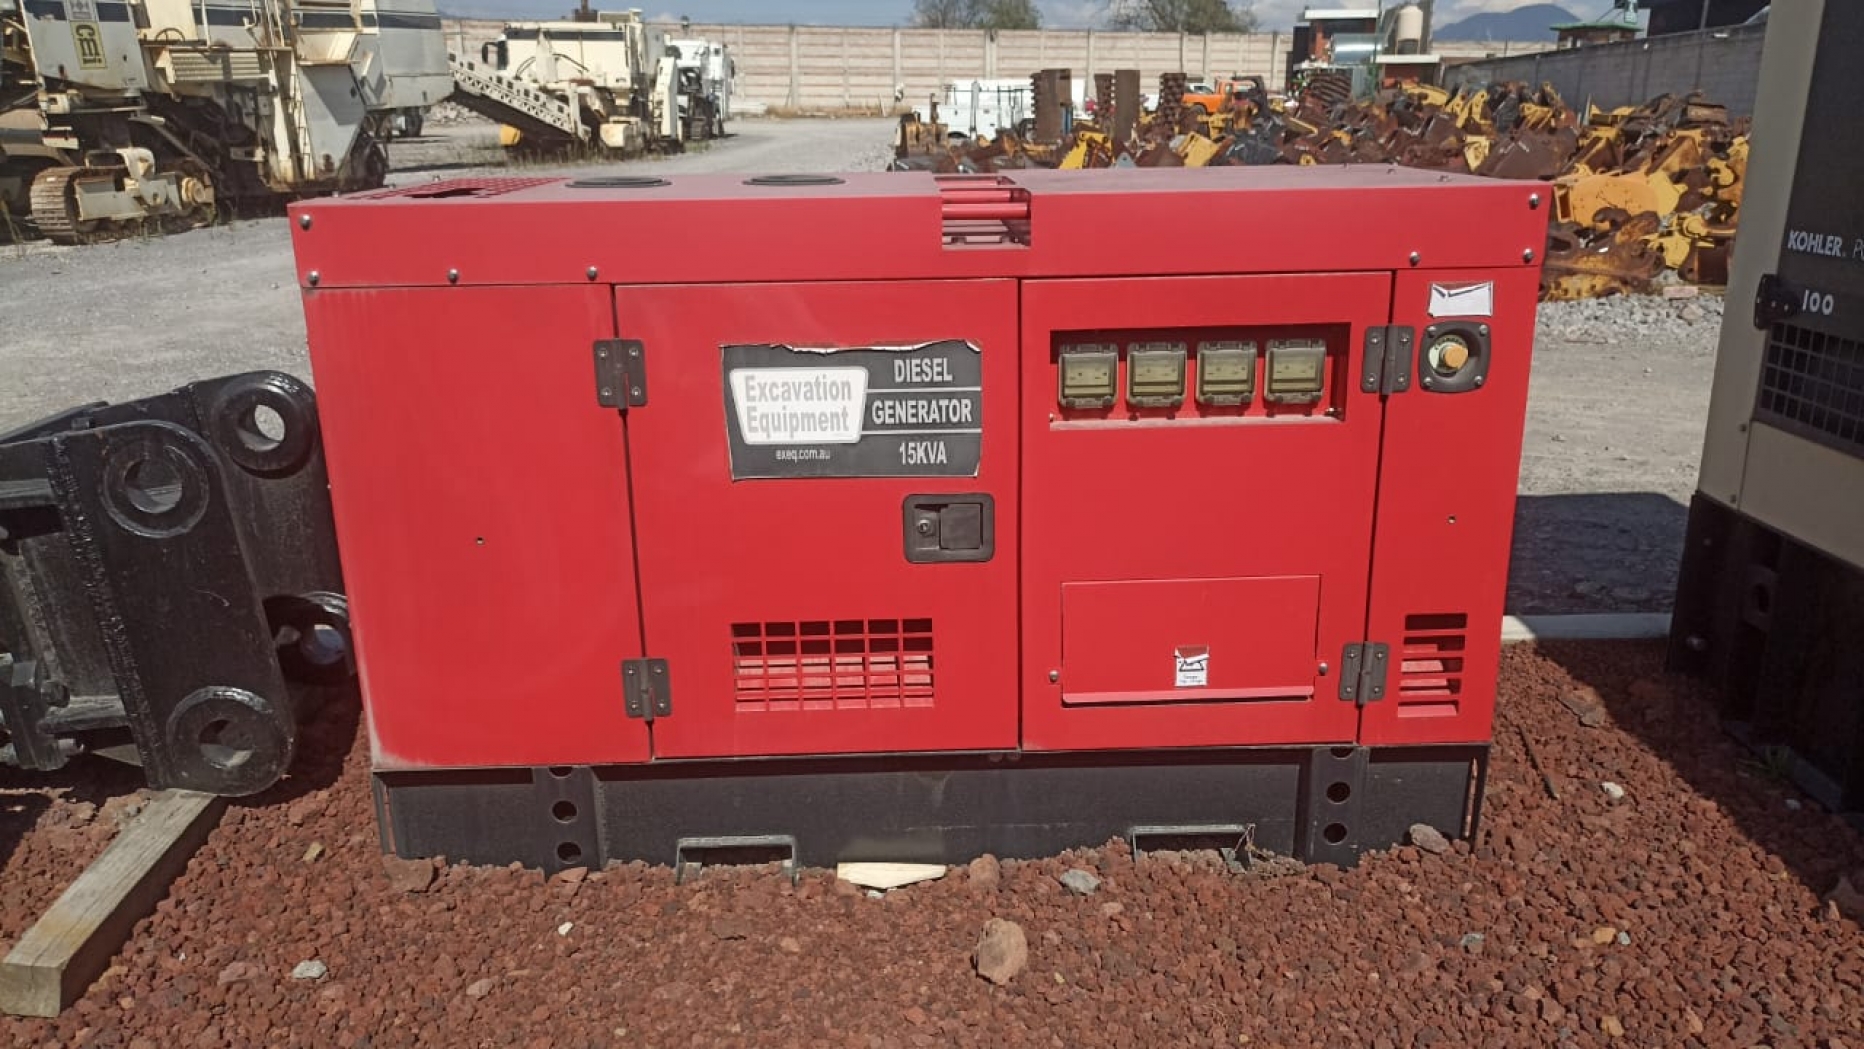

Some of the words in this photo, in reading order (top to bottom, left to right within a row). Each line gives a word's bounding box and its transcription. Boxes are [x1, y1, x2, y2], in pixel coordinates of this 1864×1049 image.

[1802, 289, 1834, 315] 100
[894, 357, 953, 383] DIESEL
[745, 374, 851, 402] Excavation
[746, 405, 849, 439] Equipment
[872, 398, 972, 424] GENERATOR
[775, 449, 831, 463] exeq.com.au
[899, 441, 947, 465] 15KVA
